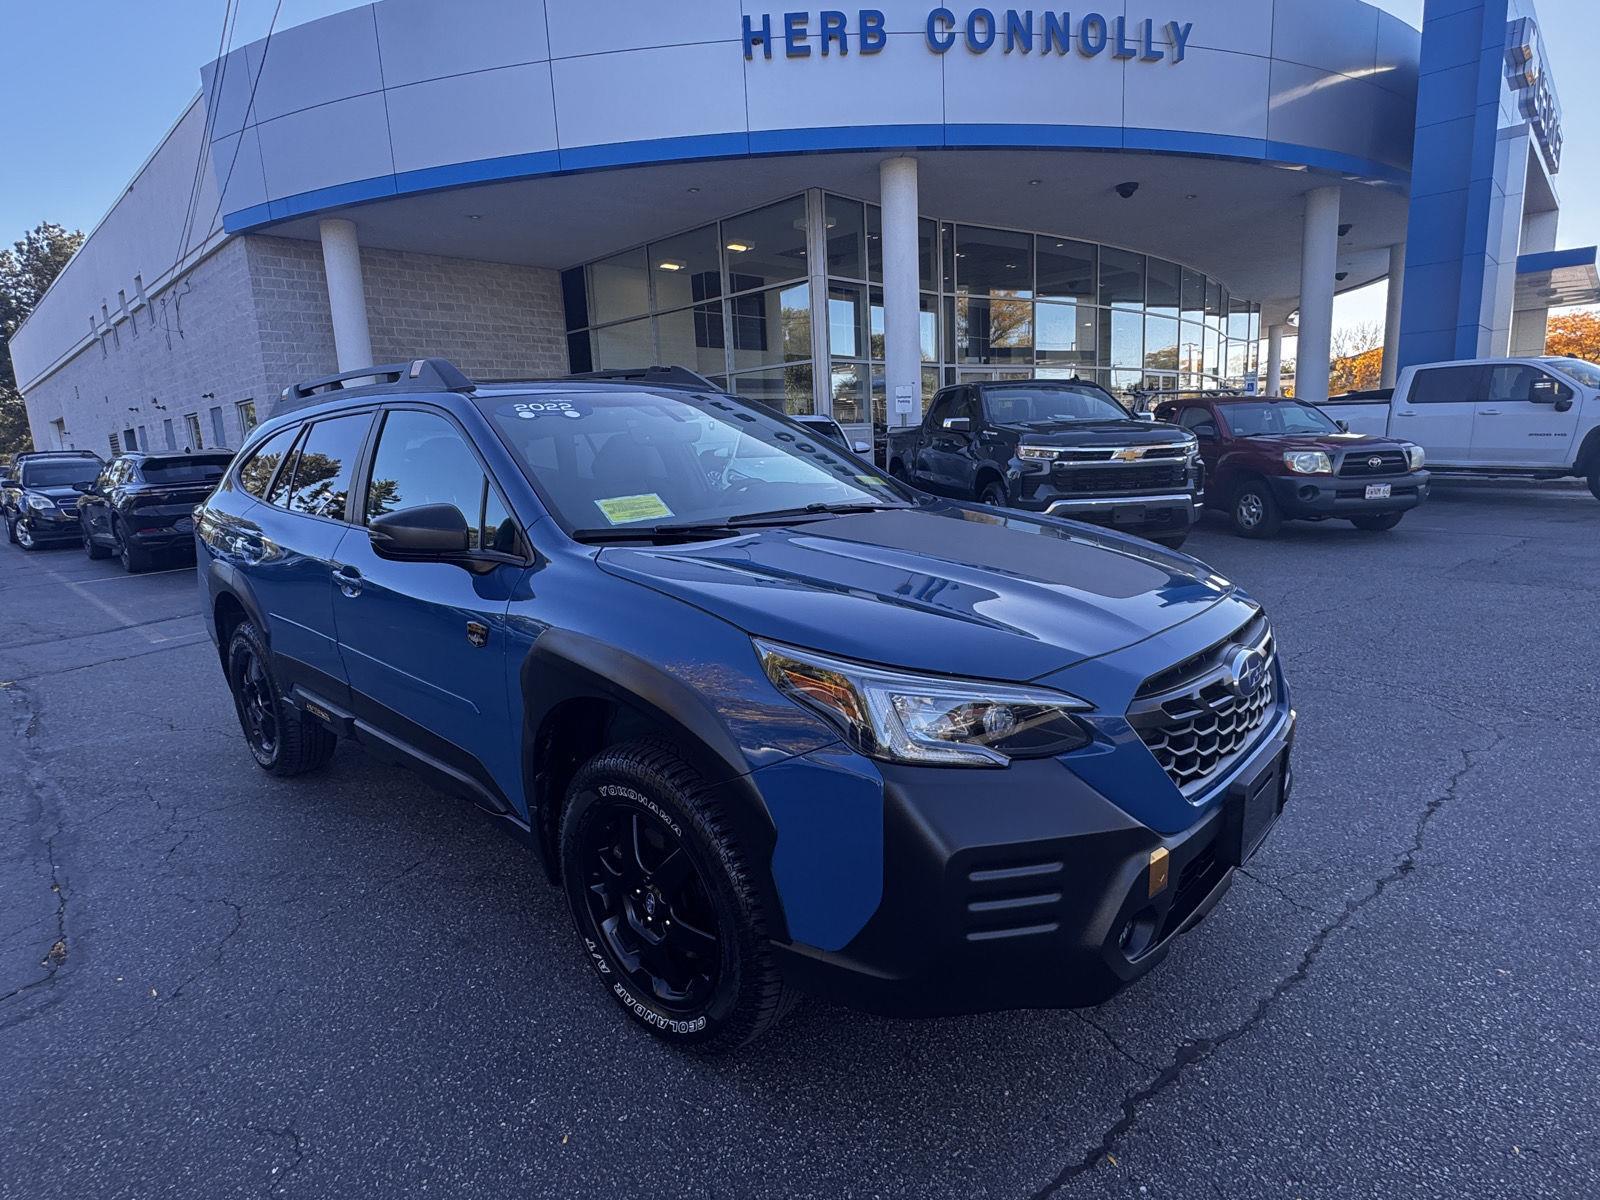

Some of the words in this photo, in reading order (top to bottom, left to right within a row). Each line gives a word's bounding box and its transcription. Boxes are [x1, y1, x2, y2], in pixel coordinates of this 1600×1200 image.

[742, 9, 887, 60] HERB
[926, 7, 1193, 64] CONNOLLY
[513, 402, 575, 412] 2022
[598, 784, 682, 837] YOKOHAMA
[585, 938, 610, 973] A/T
[613, 982, 706, 1034] GEOLANDAR
